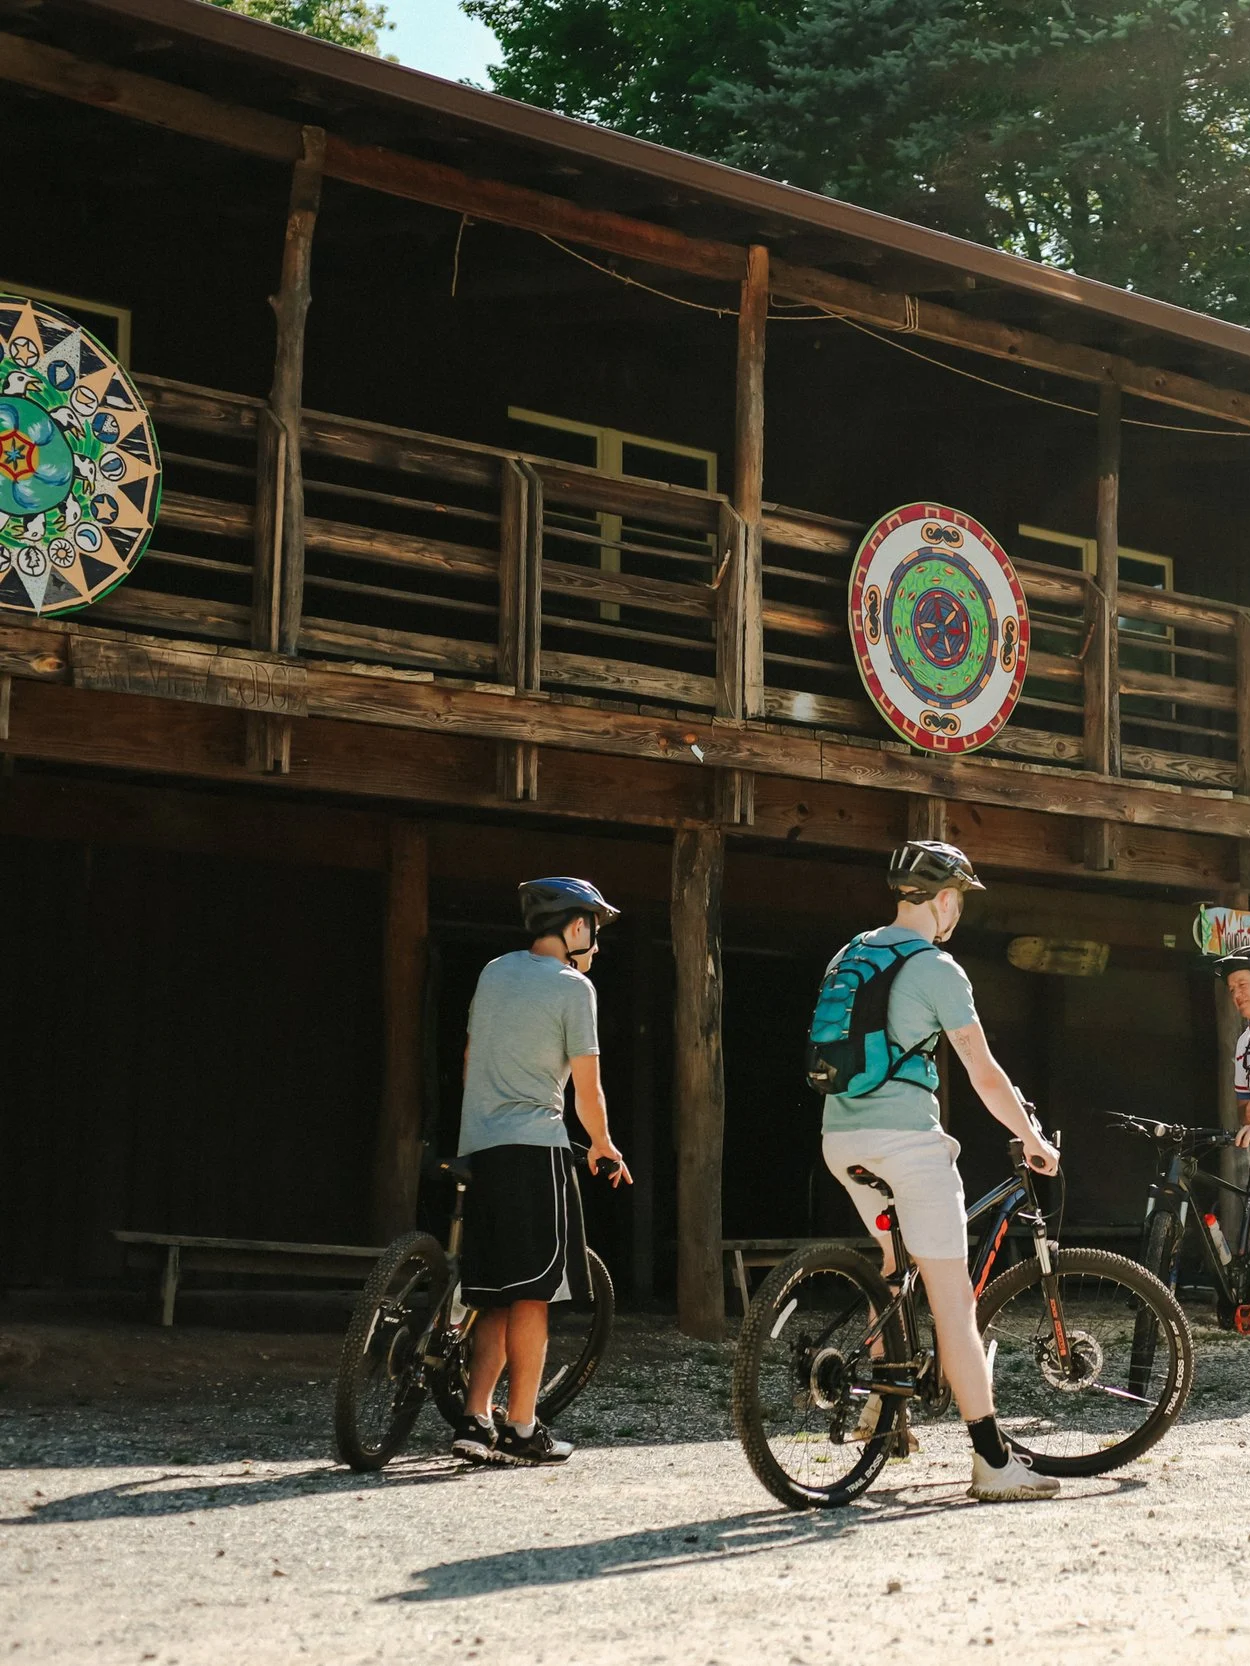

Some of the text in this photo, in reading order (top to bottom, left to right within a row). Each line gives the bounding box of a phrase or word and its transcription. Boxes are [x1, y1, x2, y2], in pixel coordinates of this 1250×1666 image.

[1164, 1389, 1181, 1415] TRAIL
[1175, 1359, 1184, 1388] BOSS
[845, 1453, 884, 1494] TRAIL BOSS
